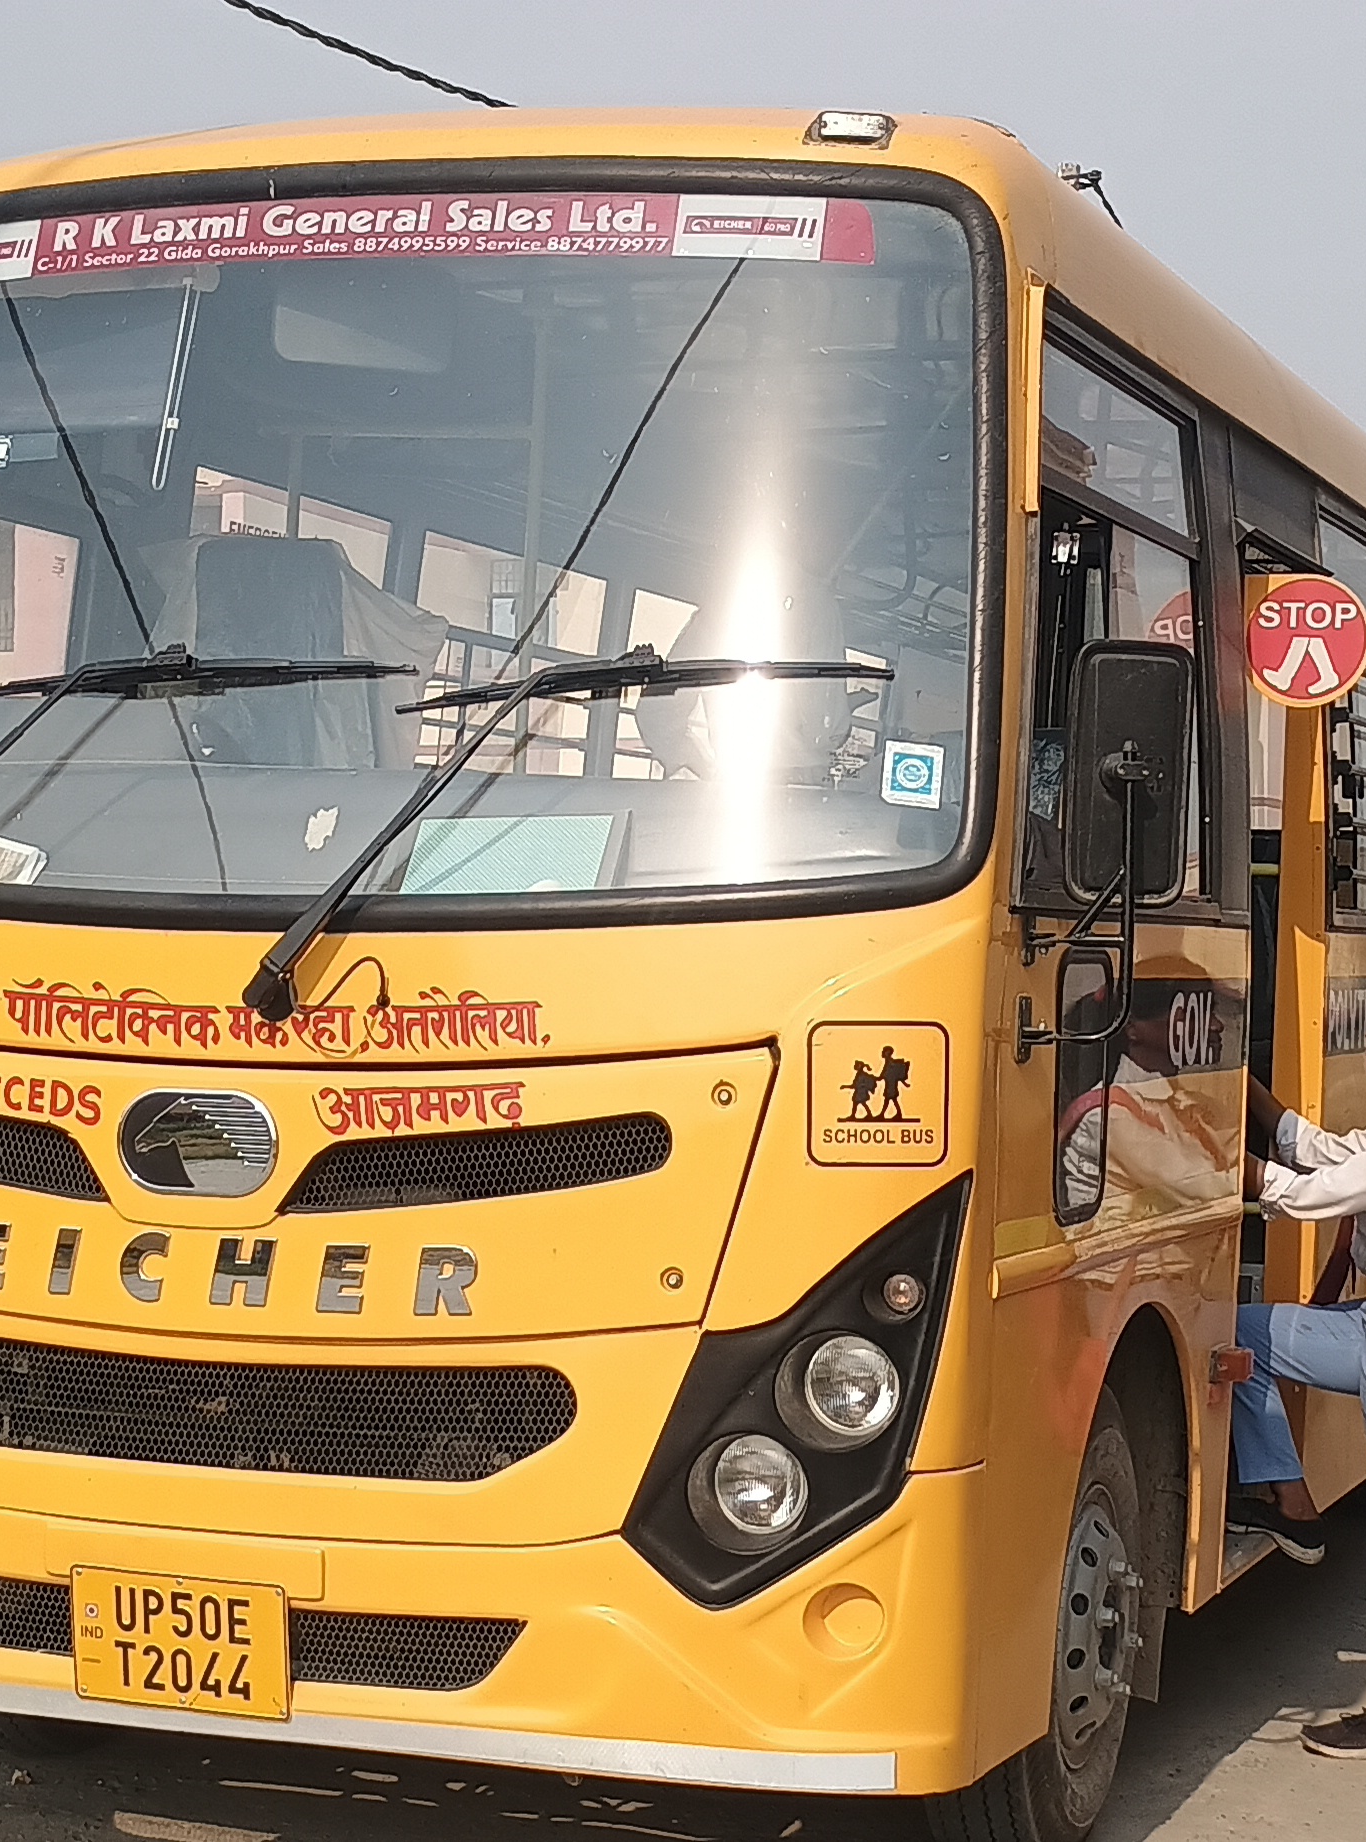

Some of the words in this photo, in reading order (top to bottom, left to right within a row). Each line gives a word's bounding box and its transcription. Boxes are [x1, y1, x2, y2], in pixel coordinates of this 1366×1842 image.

[54, 220, 80, 251] R
[92, 215, 122, 248] K
[130, 207, 249, 245] Laxmi
[263, 202, 432, 237] General
[446, 200, 553, 233] Sales
[568, 200, 658, 233] Ltd.
[37, 254, 78, 271] C-1/1
[83, 252, 134, 267] Sector
[137, 247, 159, 263] 22
[164, 245, 202, 260] Gida
[208, 241, 297, 259] Gorakhpur
[302, 239, 347, 253] Sales
[354, 236, 470, 252] 8874995599
[475, 236, 542, 252] Service
[546, 236, 669, 251] 8874779977
[1258, 601, 1357, 628] STOP
[3, 977, 221, 1050] पॉलिटेक्निक
[822, 1128, 896, 1144] SCHOOL
[900, 1129, 934, 1144] BUS
[80, 1624, 104, 1639] IND
[114, 1585, 252, 1646] UP50E
[114, 1639, 251, 1701] T2044
